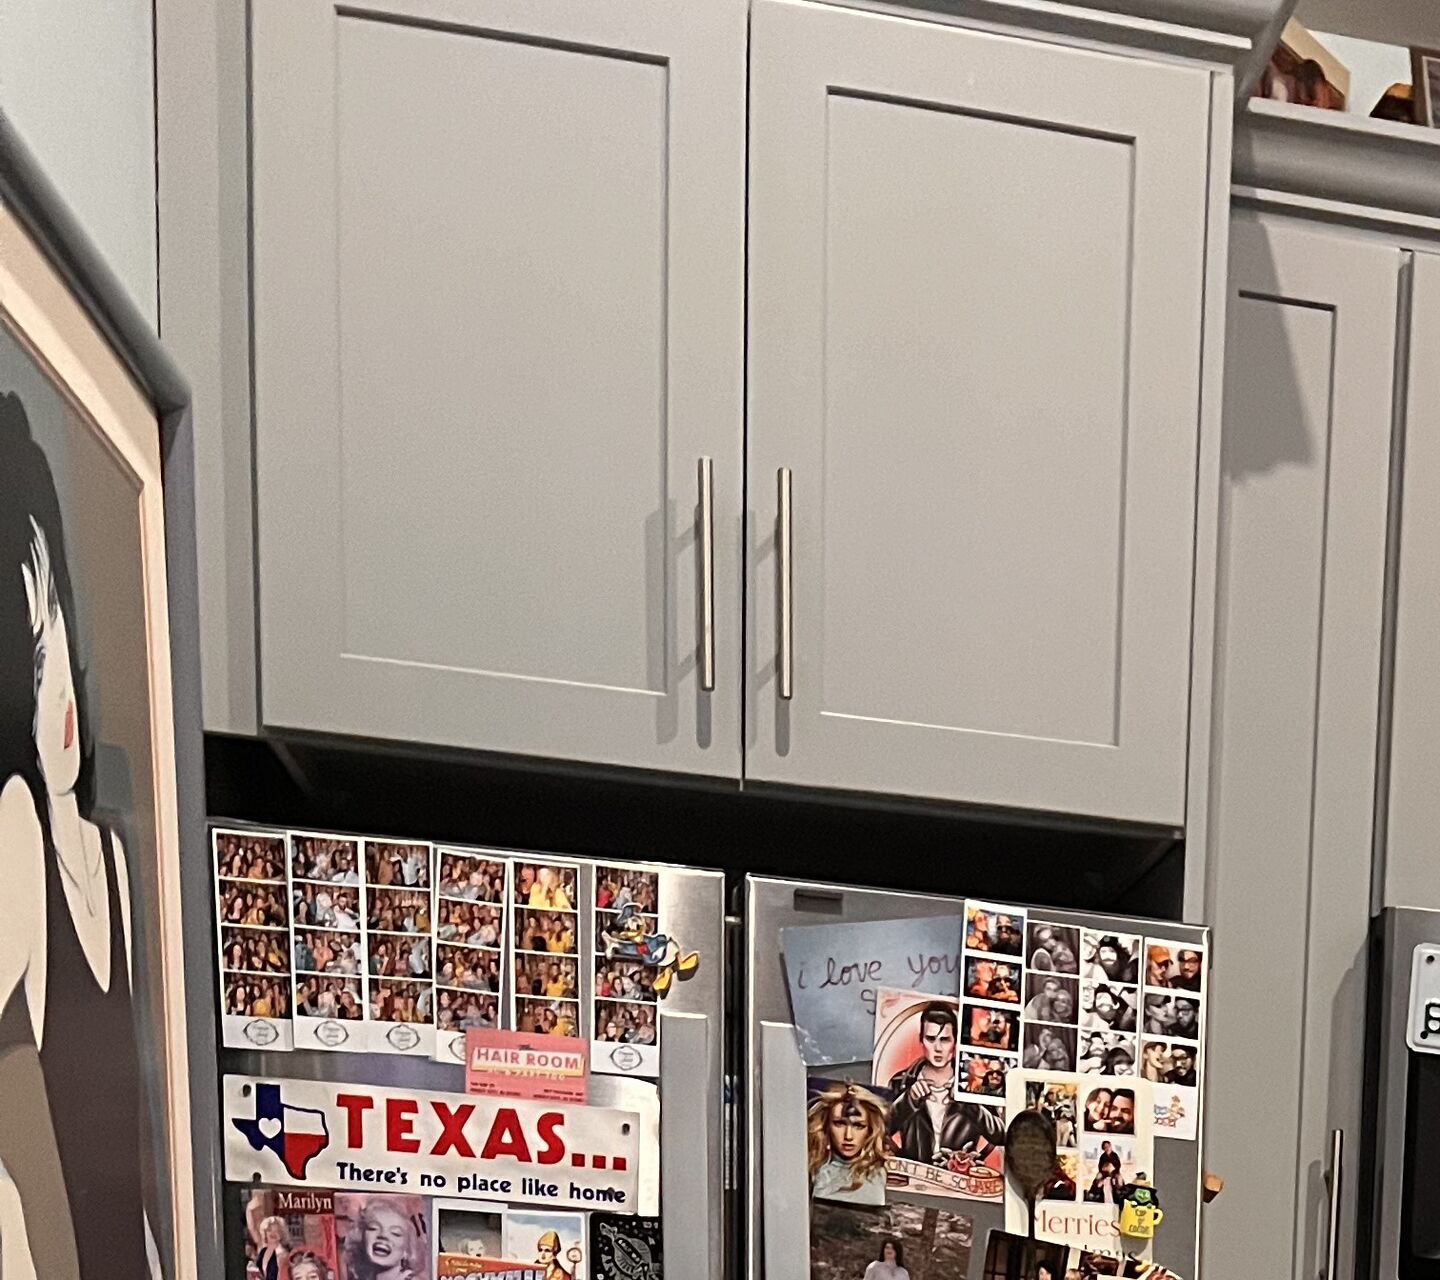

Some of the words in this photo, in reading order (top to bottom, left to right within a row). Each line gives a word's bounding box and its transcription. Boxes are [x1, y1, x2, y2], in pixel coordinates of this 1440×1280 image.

[820, 957, 882, 988] love
[477, 1048, 521, 1065] HAIR
[526, 1052, 580, 1070] ROOM
[335, 1093, 628, 1172] TEXAS...
[336, 1161, 408, 1185] There's
[419, 1172, 447, 1189] no
[457, 1173, 513, 1193] place
[521, 1177, 559, 1197] like
[569, 1182, 627, 1204] home
[926, 1167, 943, 1182] BE
[950, 1174, 1004, 1194] SQUARE
[278, 1193, 333, 1213] Marilyn
